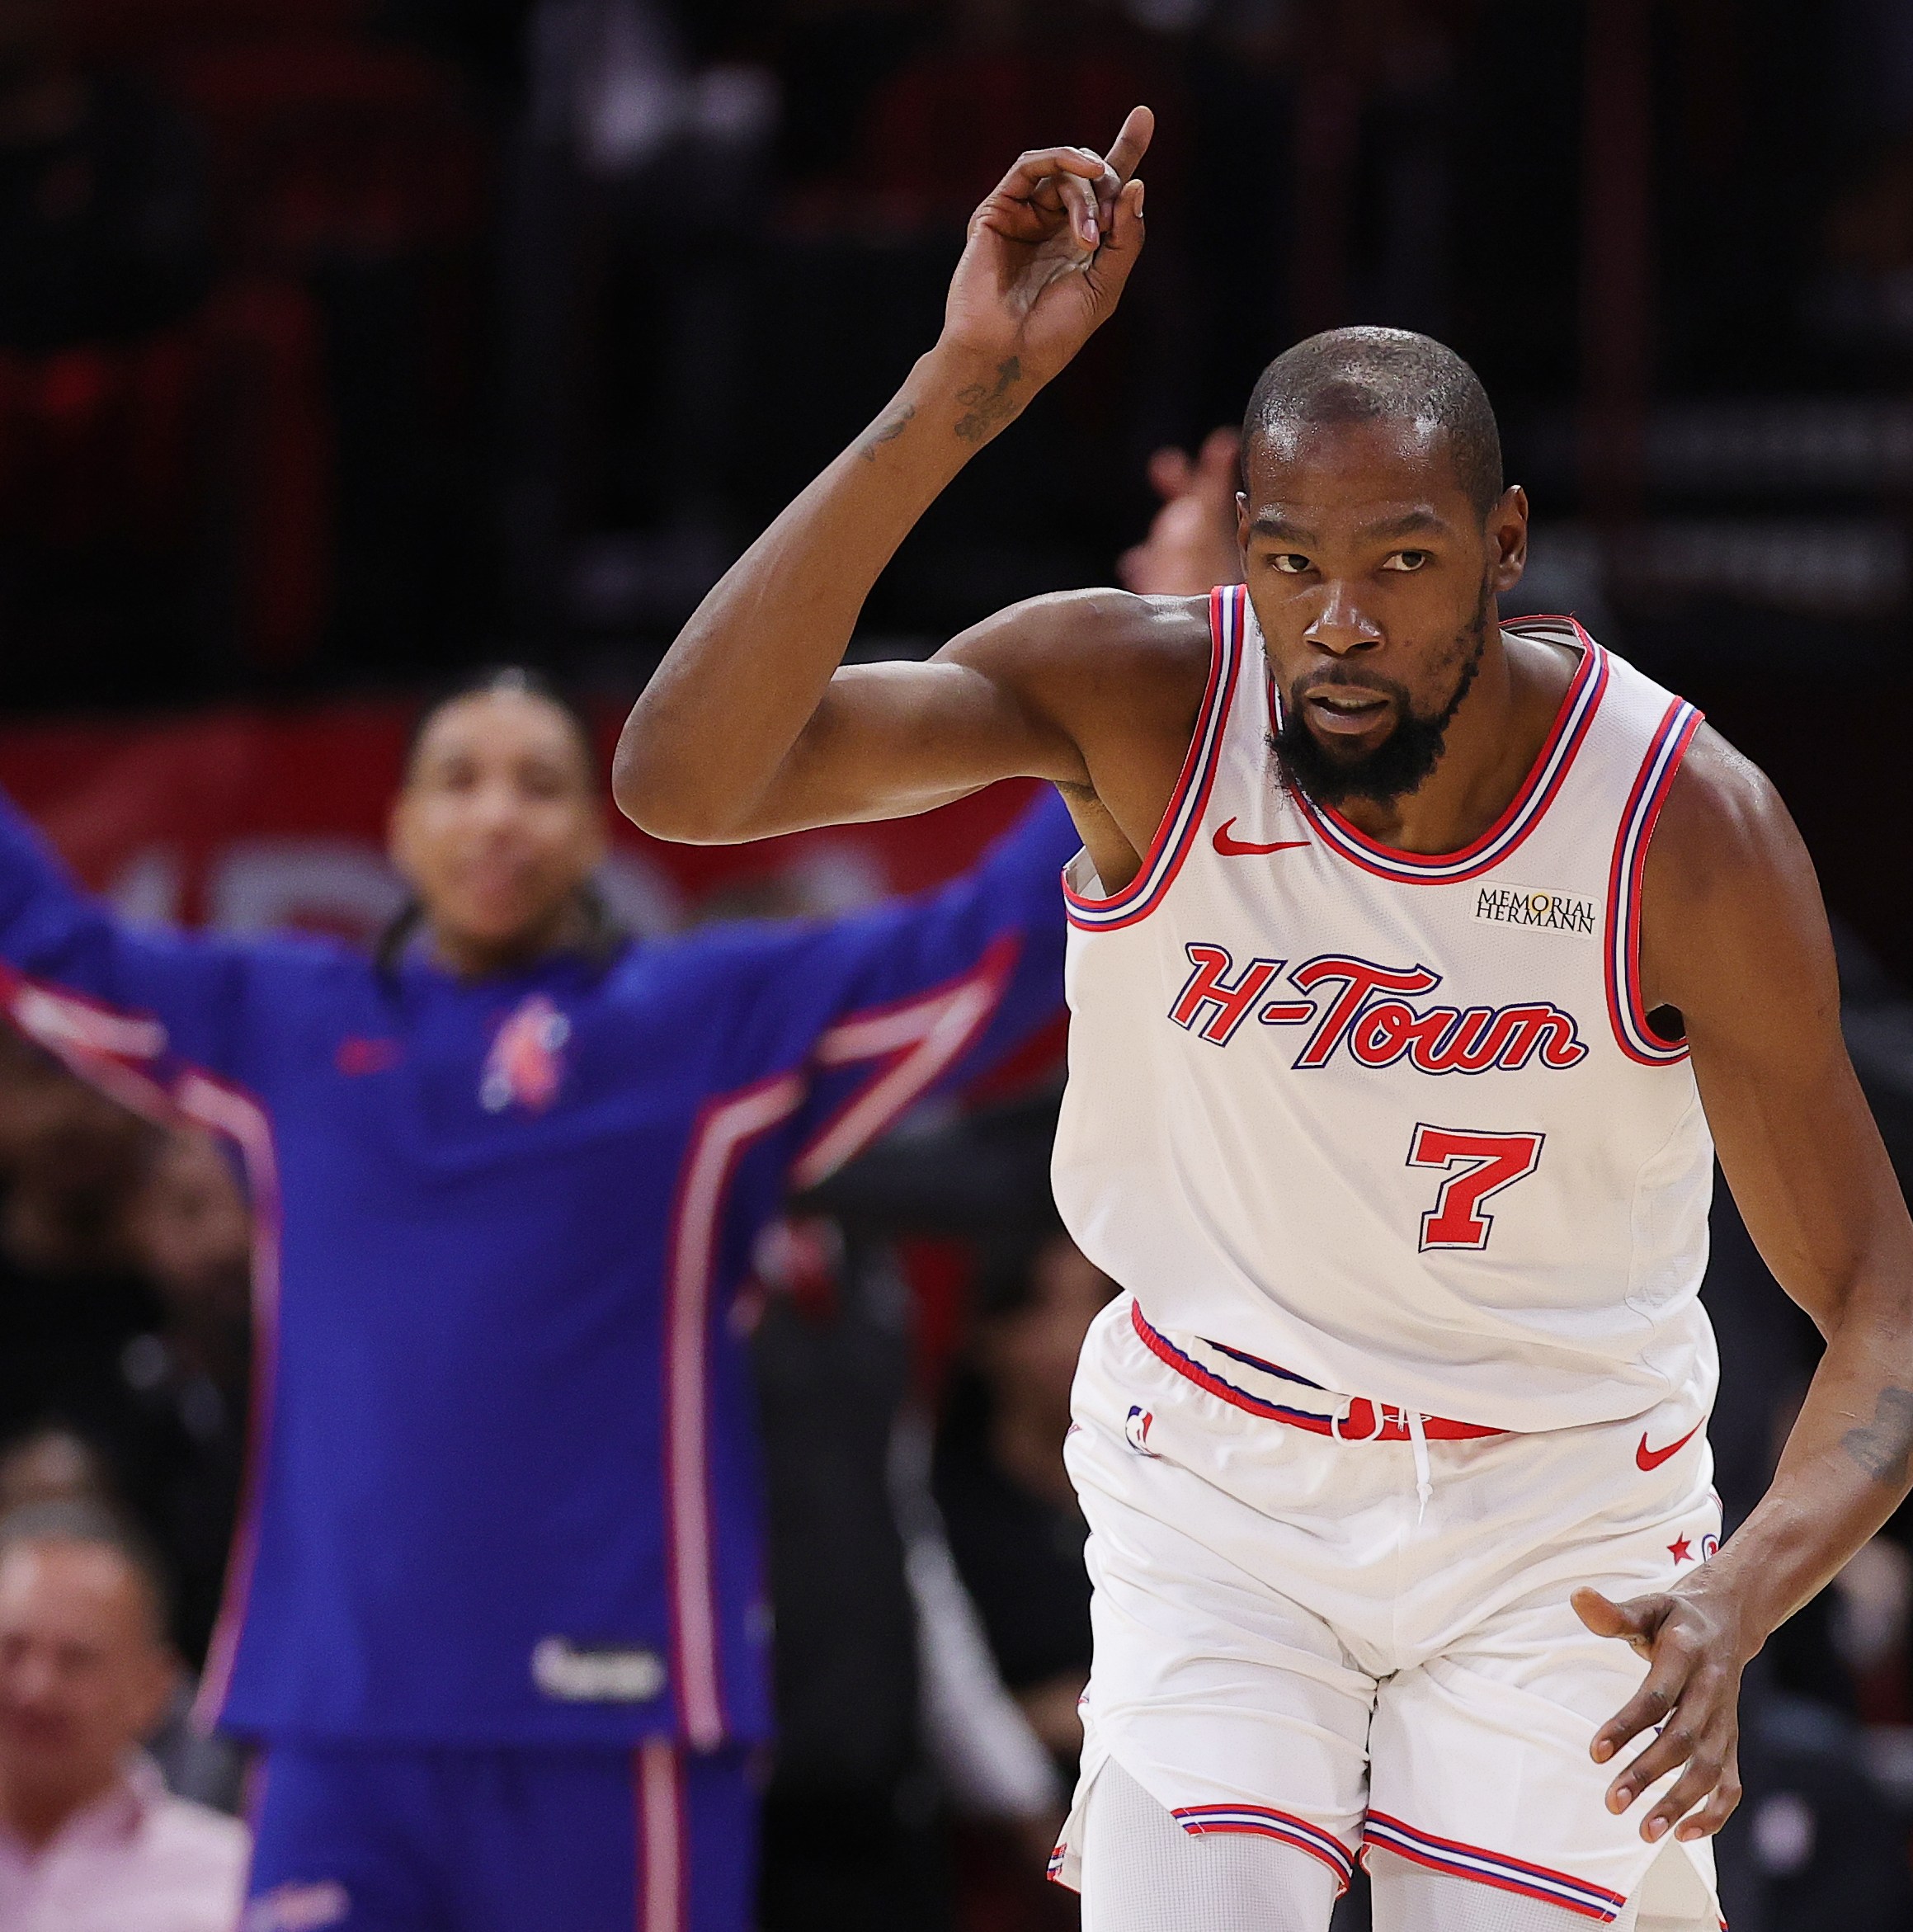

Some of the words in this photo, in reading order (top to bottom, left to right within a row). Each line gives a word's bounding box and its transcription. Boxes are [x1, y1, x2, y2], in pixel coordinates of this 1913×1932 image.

[1476, 902, 1595, 935] HERMANN
[1477, 888, 1595, 921] MEMORIAL
[1168, 942, 1588, 1075] H-Town
[1406, 1122, 1546, 1253] 7
